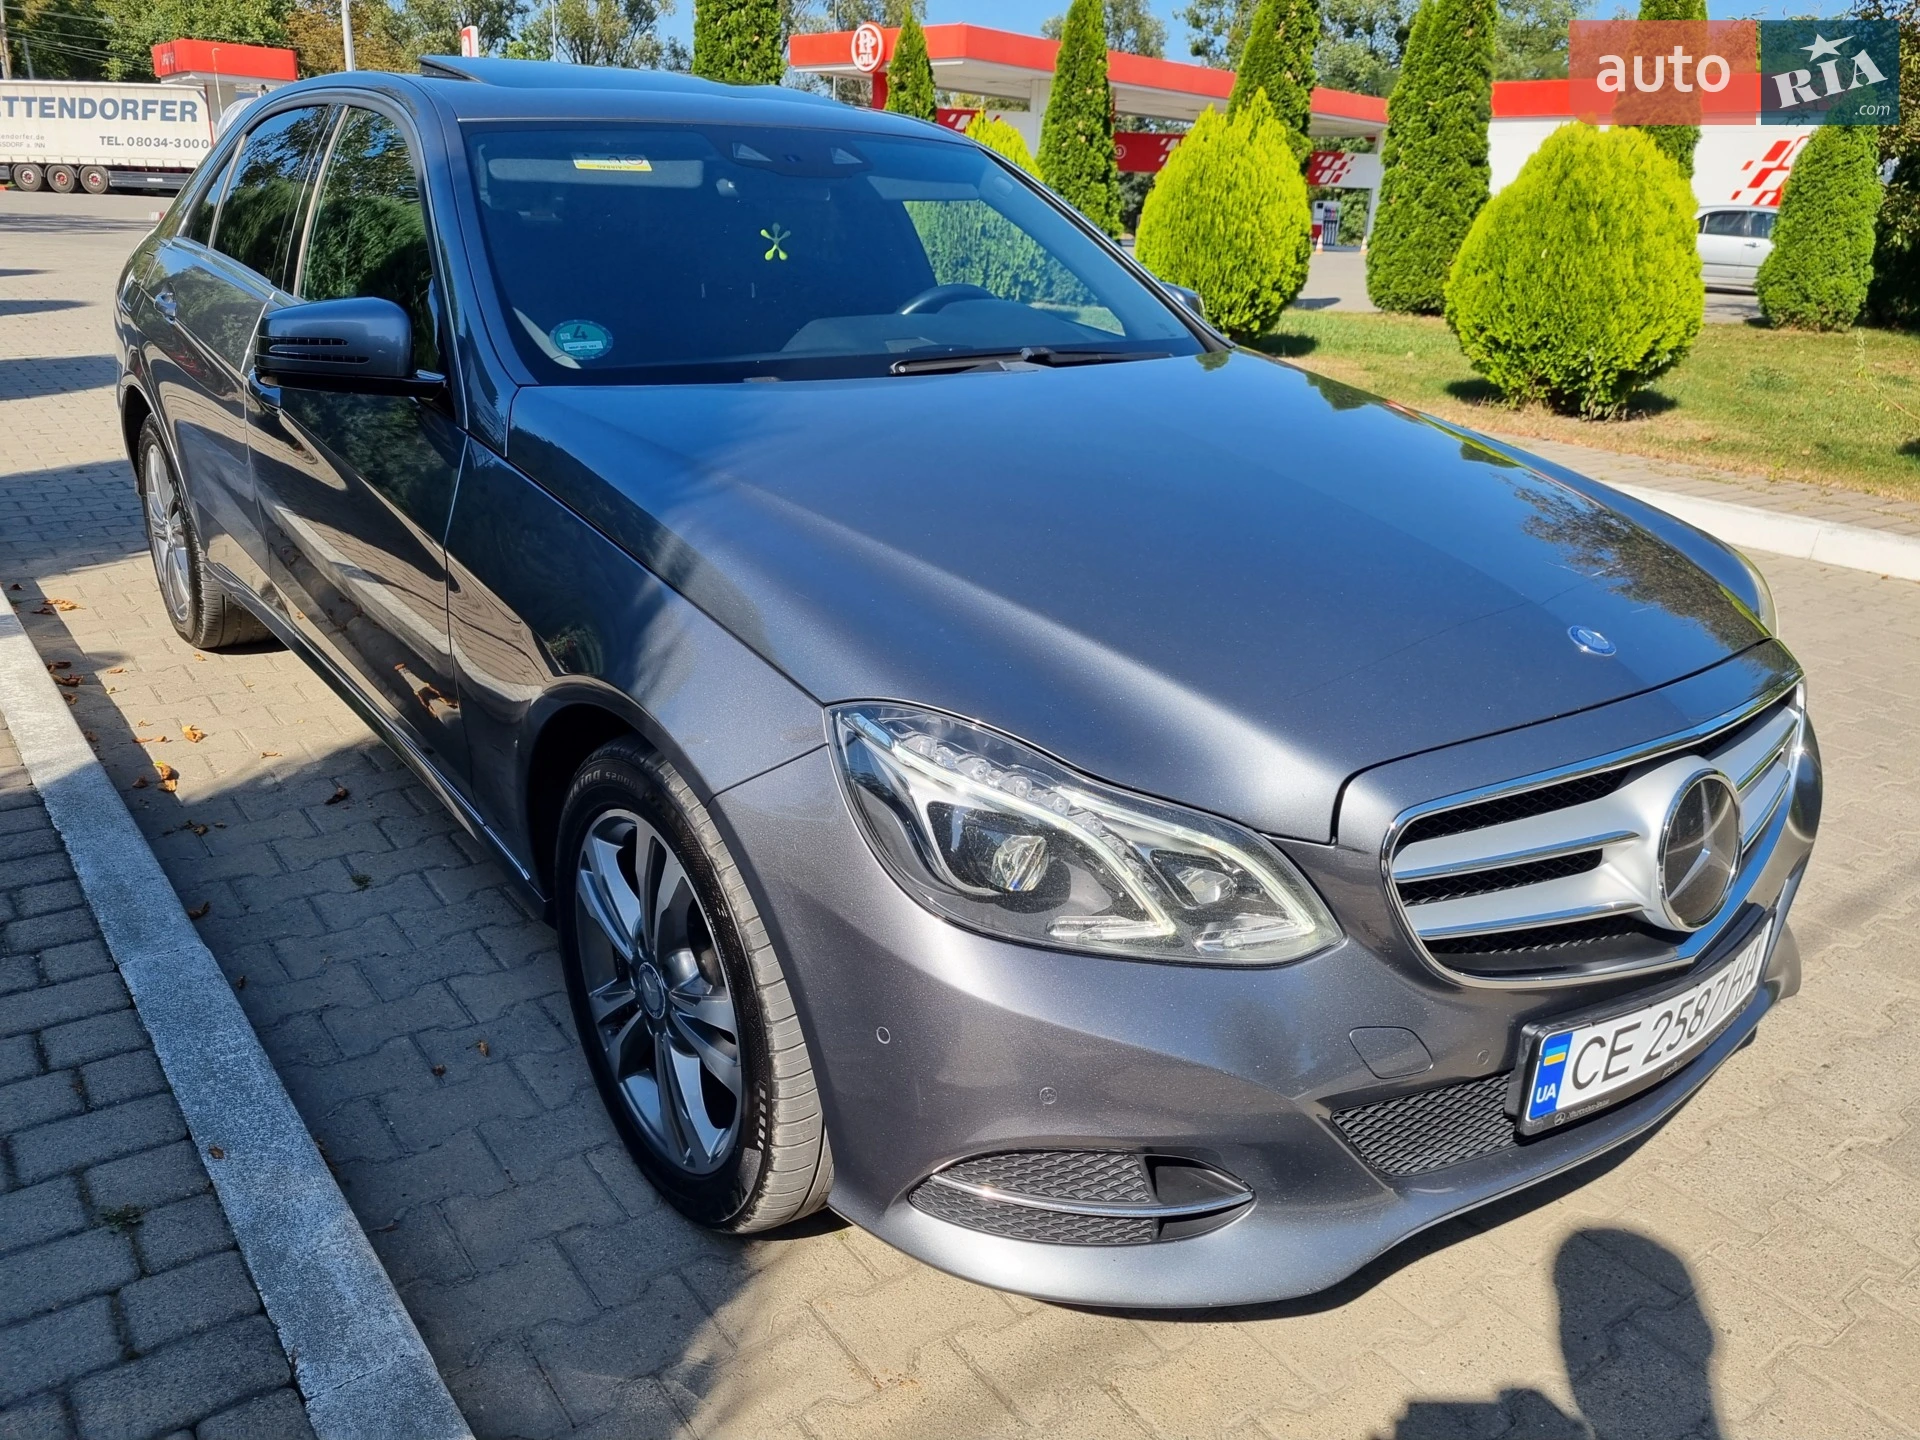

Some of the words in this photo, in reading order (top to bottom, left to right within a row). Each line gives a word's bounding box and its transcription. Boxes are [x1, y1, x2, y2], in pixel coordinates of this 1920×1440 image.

[0, 95, 198, 122] TTENDORFER
[99, 135, 124, 146] TEL.
[127, 136, 212, 149] 08034-3000
[573, 325, 588, 340] 4
[1571, 1020, 1641, 1091] CE
[1642, 970, 1730, 1066] 2587
[1723, 937, 1761, 1011] HA
[1535, 1082, 1557, 1104] UA
